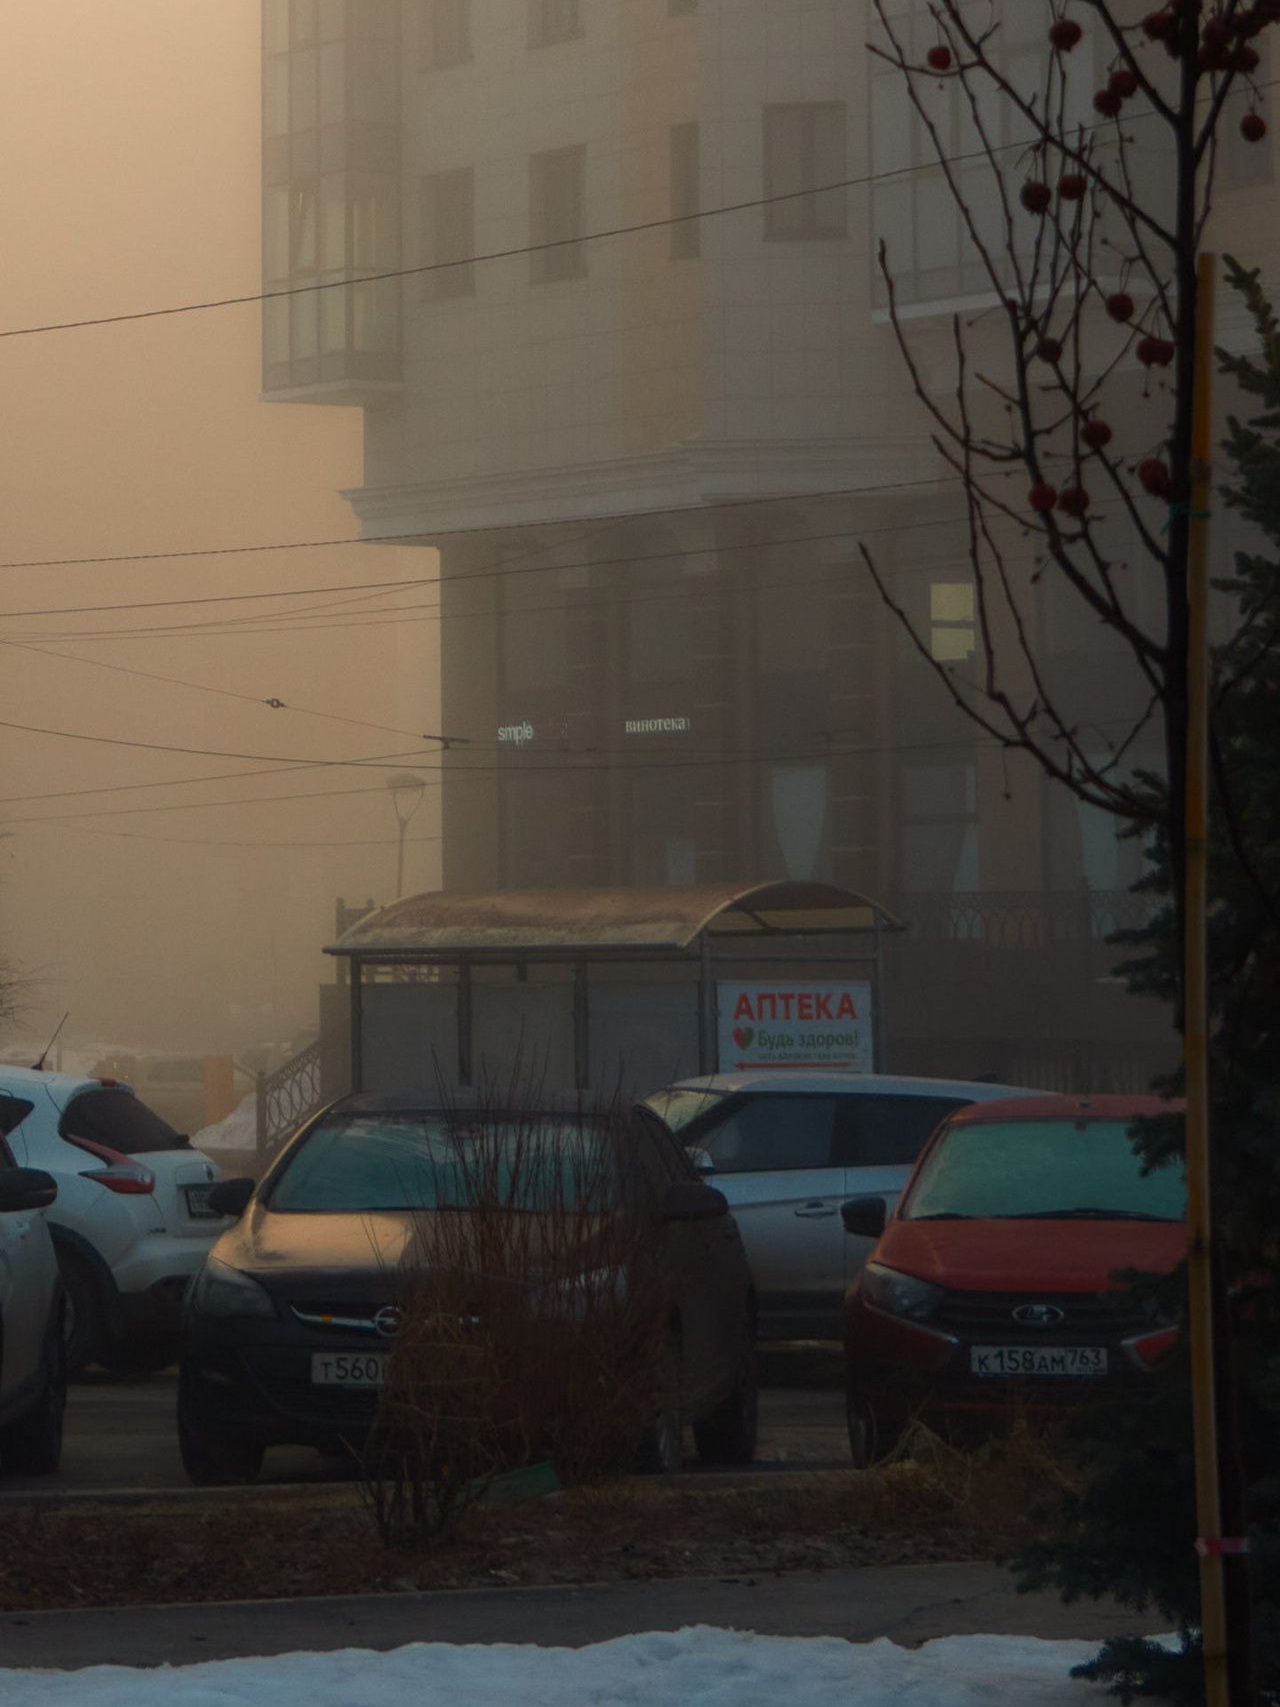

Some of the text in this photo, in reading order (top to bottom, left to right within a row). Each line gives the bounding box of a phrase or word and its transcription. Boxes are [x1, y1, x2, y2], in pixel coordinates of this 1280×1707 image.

[625, 717, 685, 733] винотека
[733, 991, 857, 1021] АПТЕКА
[758, 1029, 858, 1050] Будь здоров!
[320, 1357, 385, 1380] Т560
